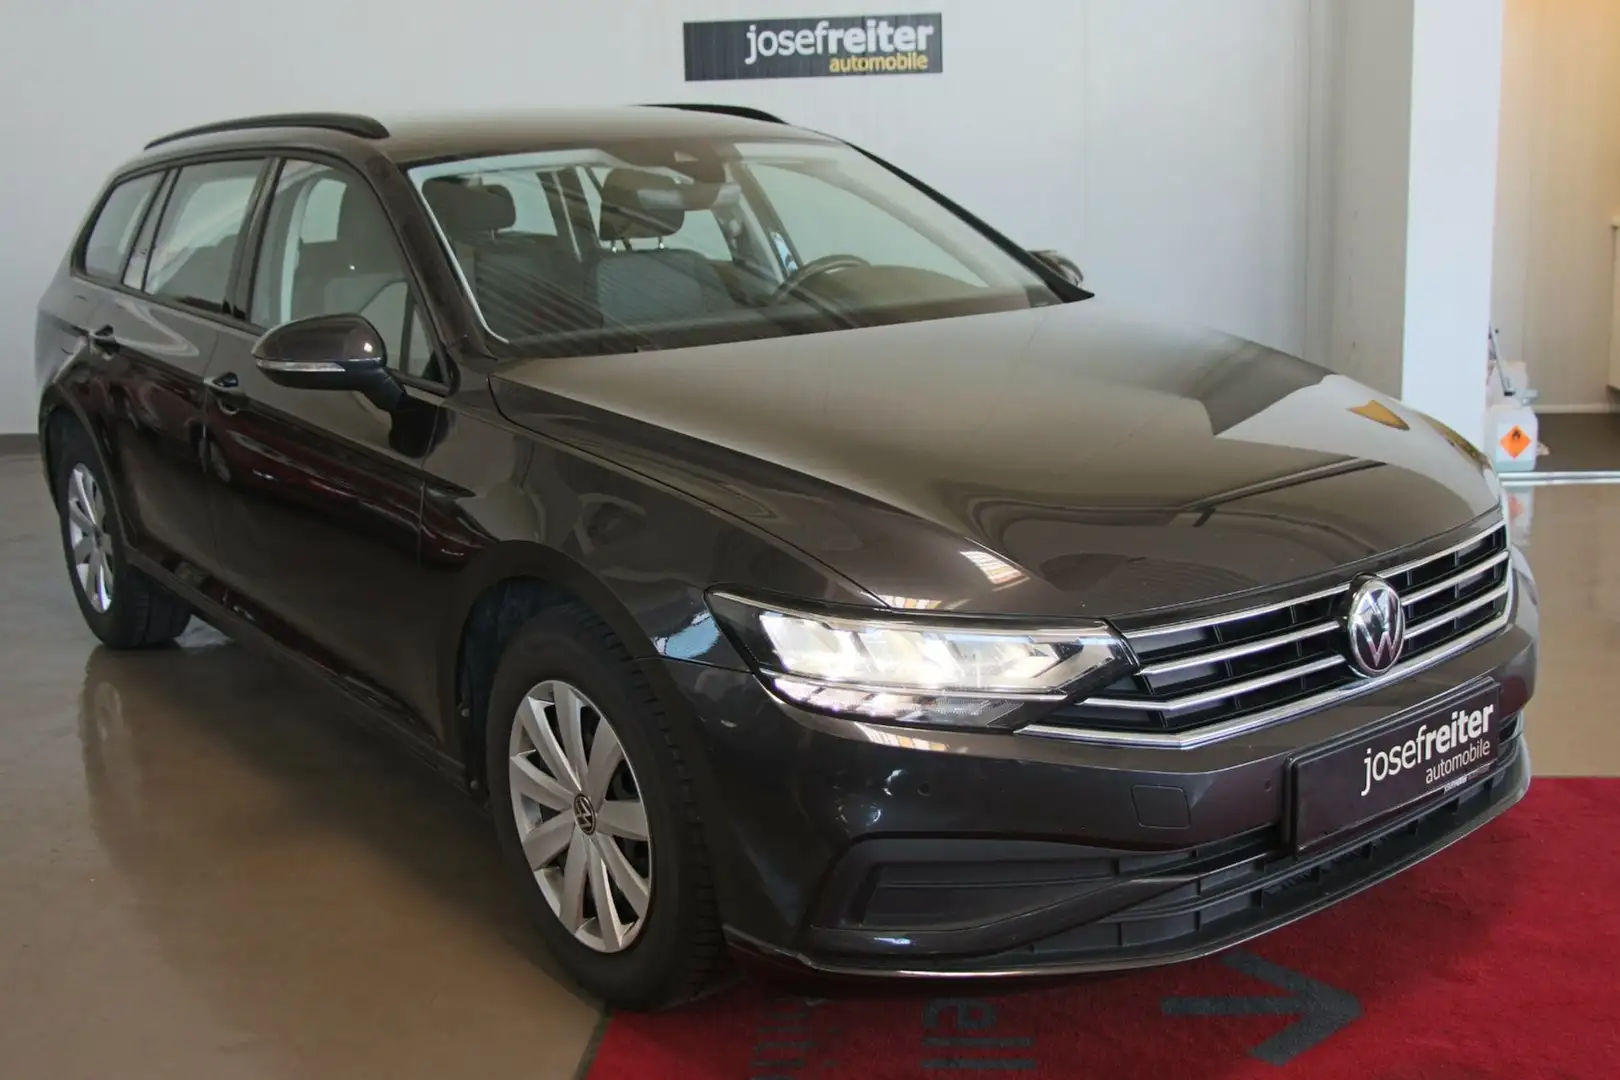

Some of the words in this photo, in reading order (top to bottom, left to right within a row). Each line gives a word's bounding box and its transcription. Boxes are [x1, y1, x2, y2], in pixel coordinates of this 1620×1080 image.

[744, 19, 934, 65] josefreiter
[829, 52, 929, 73] automobile
[1361, 703, 1494, 796] josefreiter
[1425, 738, 1491, 784] automobile
